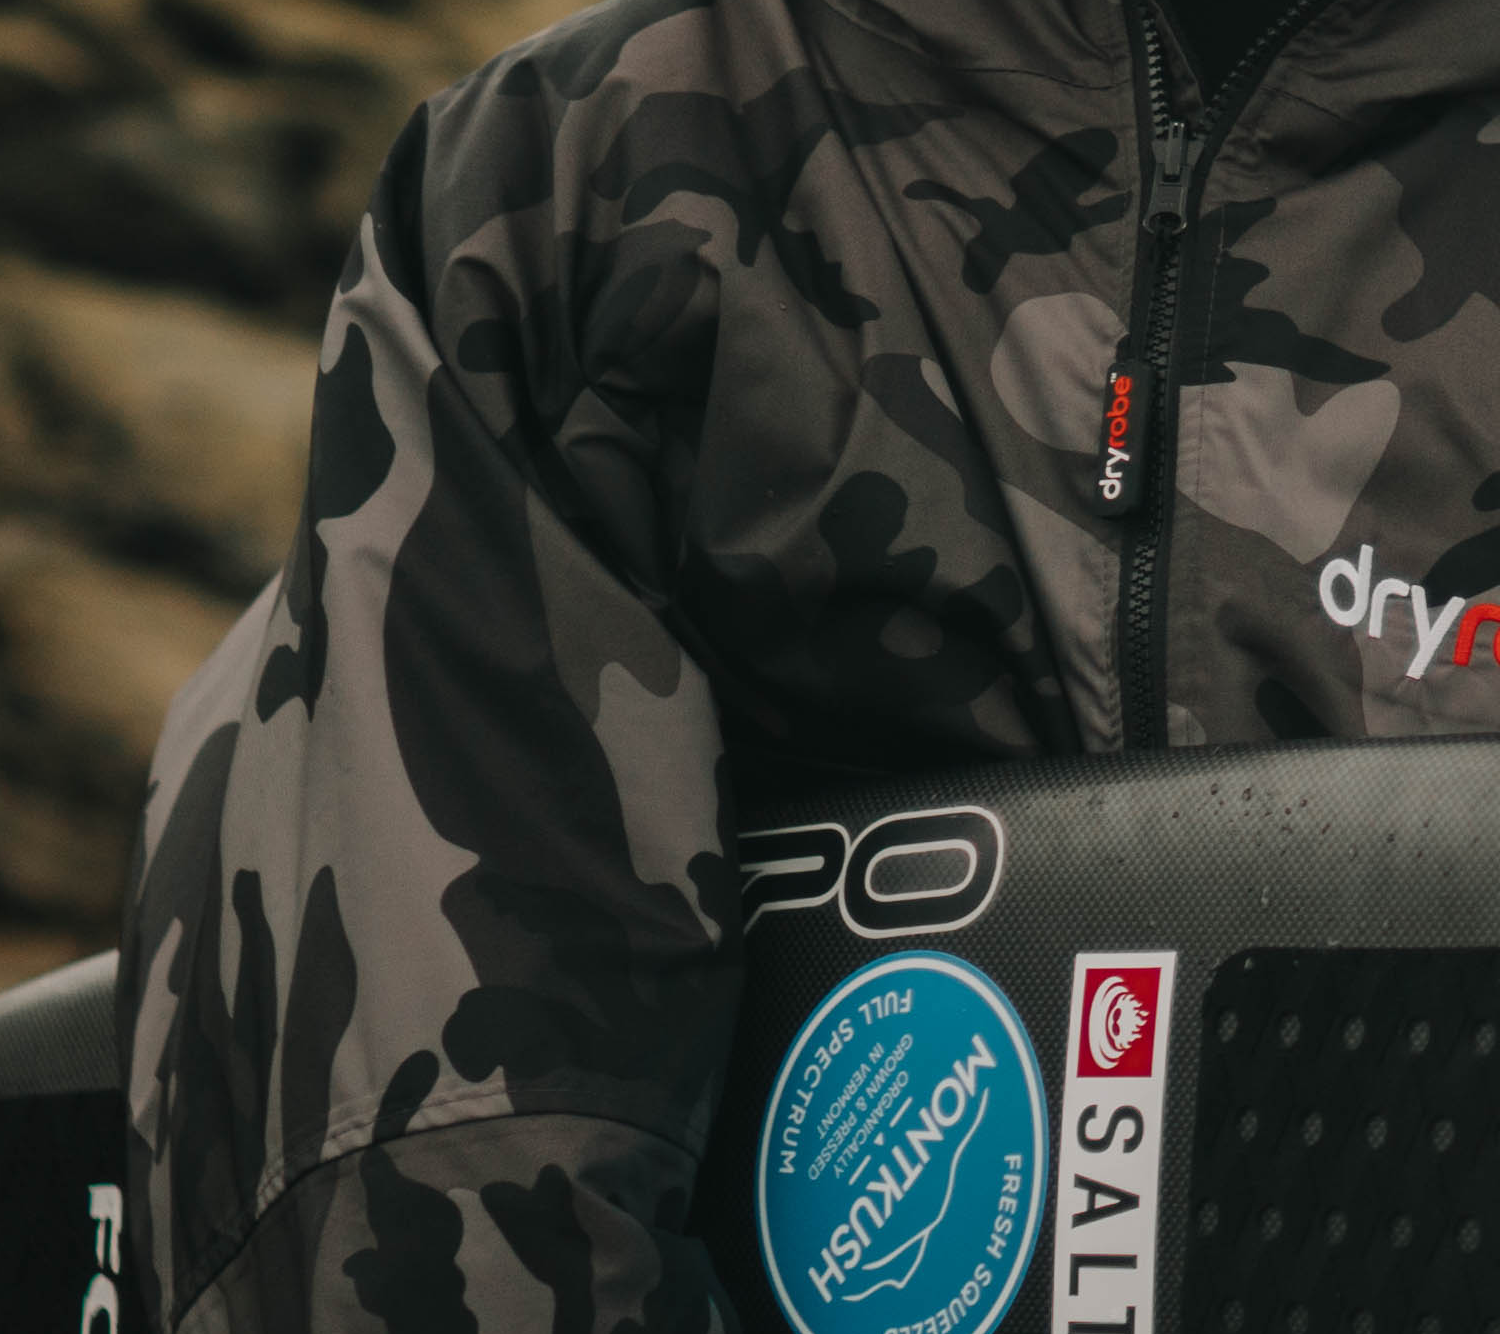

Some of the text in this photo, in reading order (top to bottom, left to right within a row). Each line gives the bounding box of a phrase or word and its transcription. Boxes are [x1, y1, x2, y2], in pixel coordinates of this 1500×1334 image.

[779, 988, 914, 1174] FULL SPECTRUM
[807, 1033, 914, 1181] GROWN & PRESSED
[816, 1042, 886, 1140] IN VERMONT
[832, 1069, 910, 1179] ORGANICALLY
[807, 1033, 998, 1303] MONTKUSH
[986, 1152, 1023, 1259] FRESH
